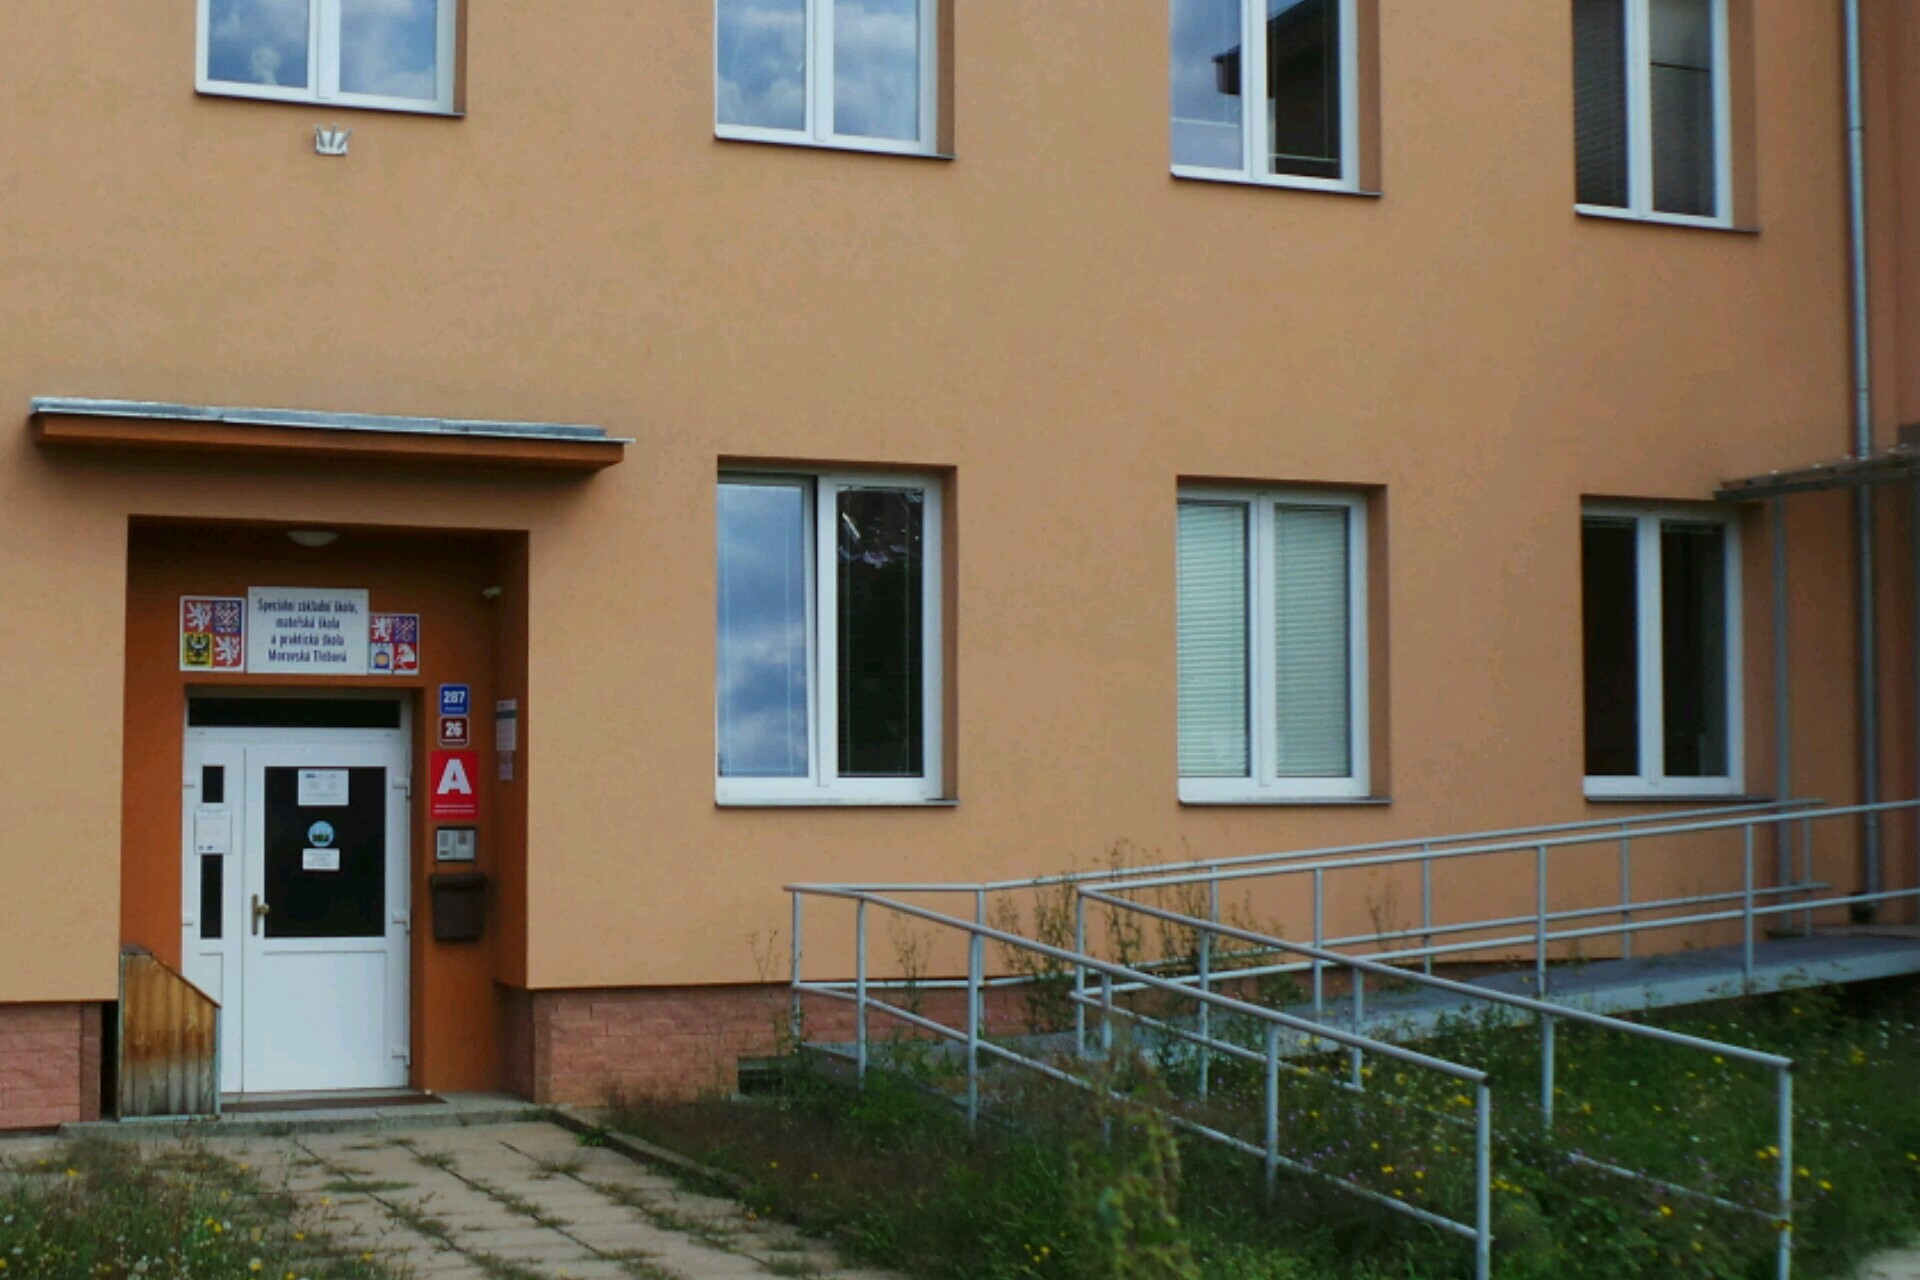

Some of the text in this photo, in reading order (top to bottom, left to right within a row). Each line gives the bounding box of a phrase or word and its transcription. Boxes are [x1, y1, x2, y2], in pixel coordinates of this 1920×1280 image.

[275, 616, 340, 628] mateřská škola
[322, 633, 344, 646] škola
[268, 649, 347, 662] Moravská Třebová
[443, 691, 465, 704] 287
[445, 721, 463, 737] 26
[436, 758, 472, 795] A
